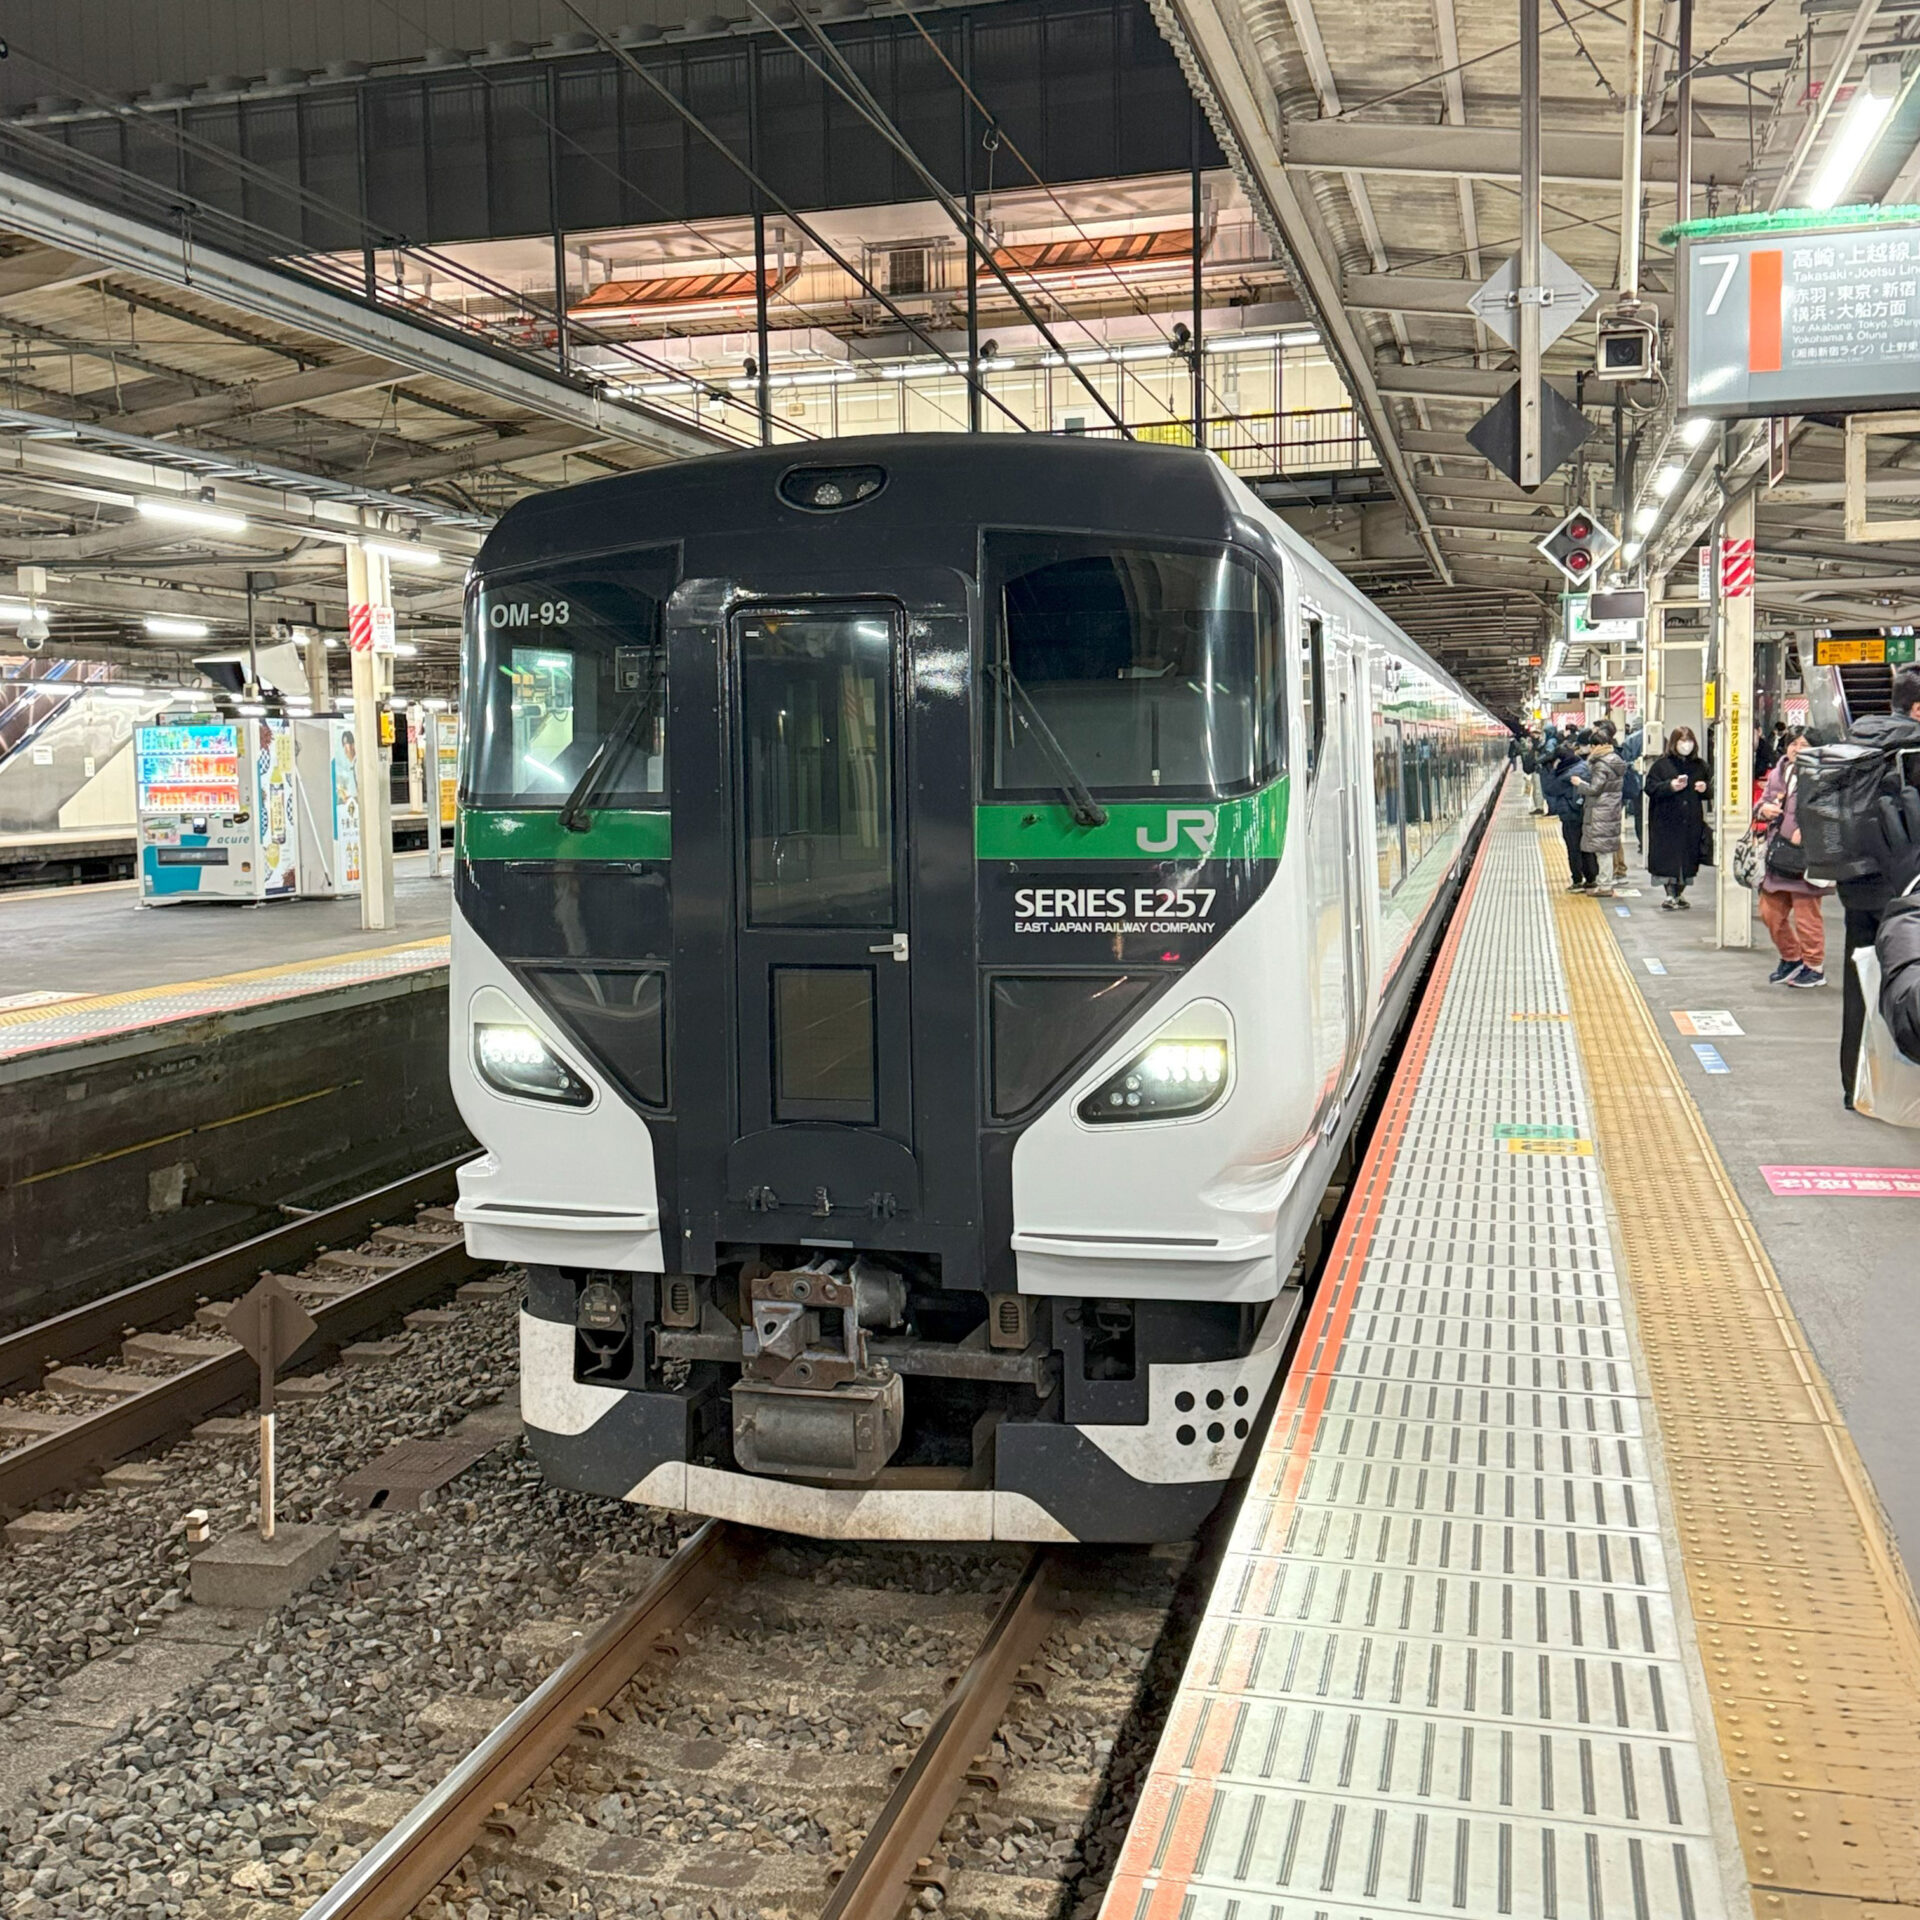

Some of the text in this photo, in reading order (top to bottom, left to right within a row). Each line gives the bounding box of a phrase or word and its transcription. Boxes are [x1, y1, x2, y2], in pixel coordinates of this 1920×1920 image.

[1699, 254, 1739, 315] 7
[1792, 299, 1906, 323] 横浜・大船方面
[1793, 334, 1844, 344] Yokohama
[490, 601, 570, 628] OM-93
[217, 835, 250, 845] acure
[1136, 810, 1216, 852] JR
[1014, 888, 1216, 918] SERIES E257
[1014, 922, 1216, 934] EAST JAPAN RAILWAY COMPANY
